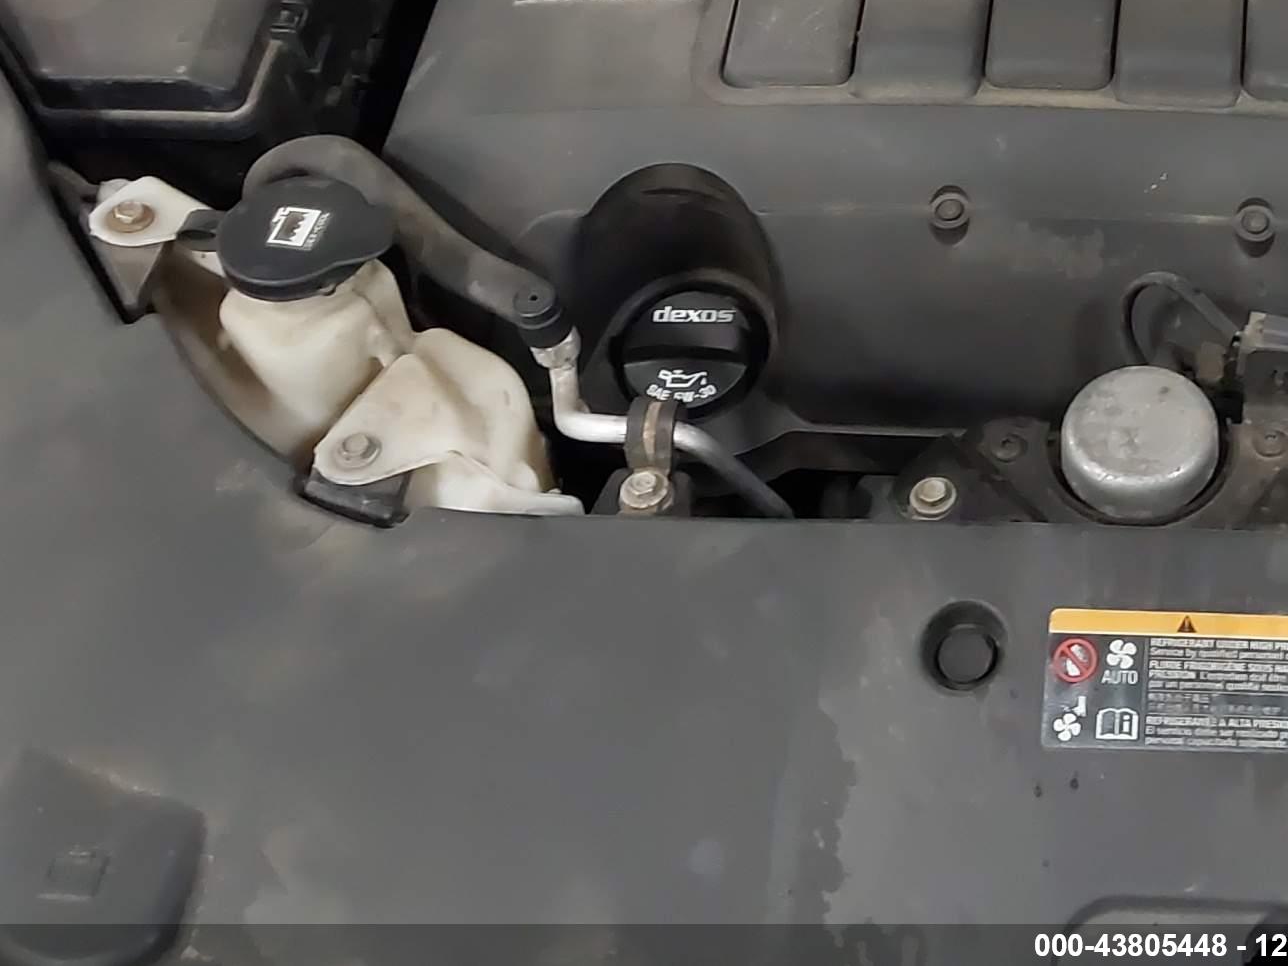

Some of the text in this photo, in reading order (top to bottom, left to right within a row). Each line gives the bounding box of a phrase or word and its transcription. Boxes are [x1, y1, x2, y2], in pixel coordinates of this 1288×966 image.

[653, 306, 736, 322] dexos
[647, 384, 672, 400] SAE
[1101, 670, 1138, 684] AUTO
